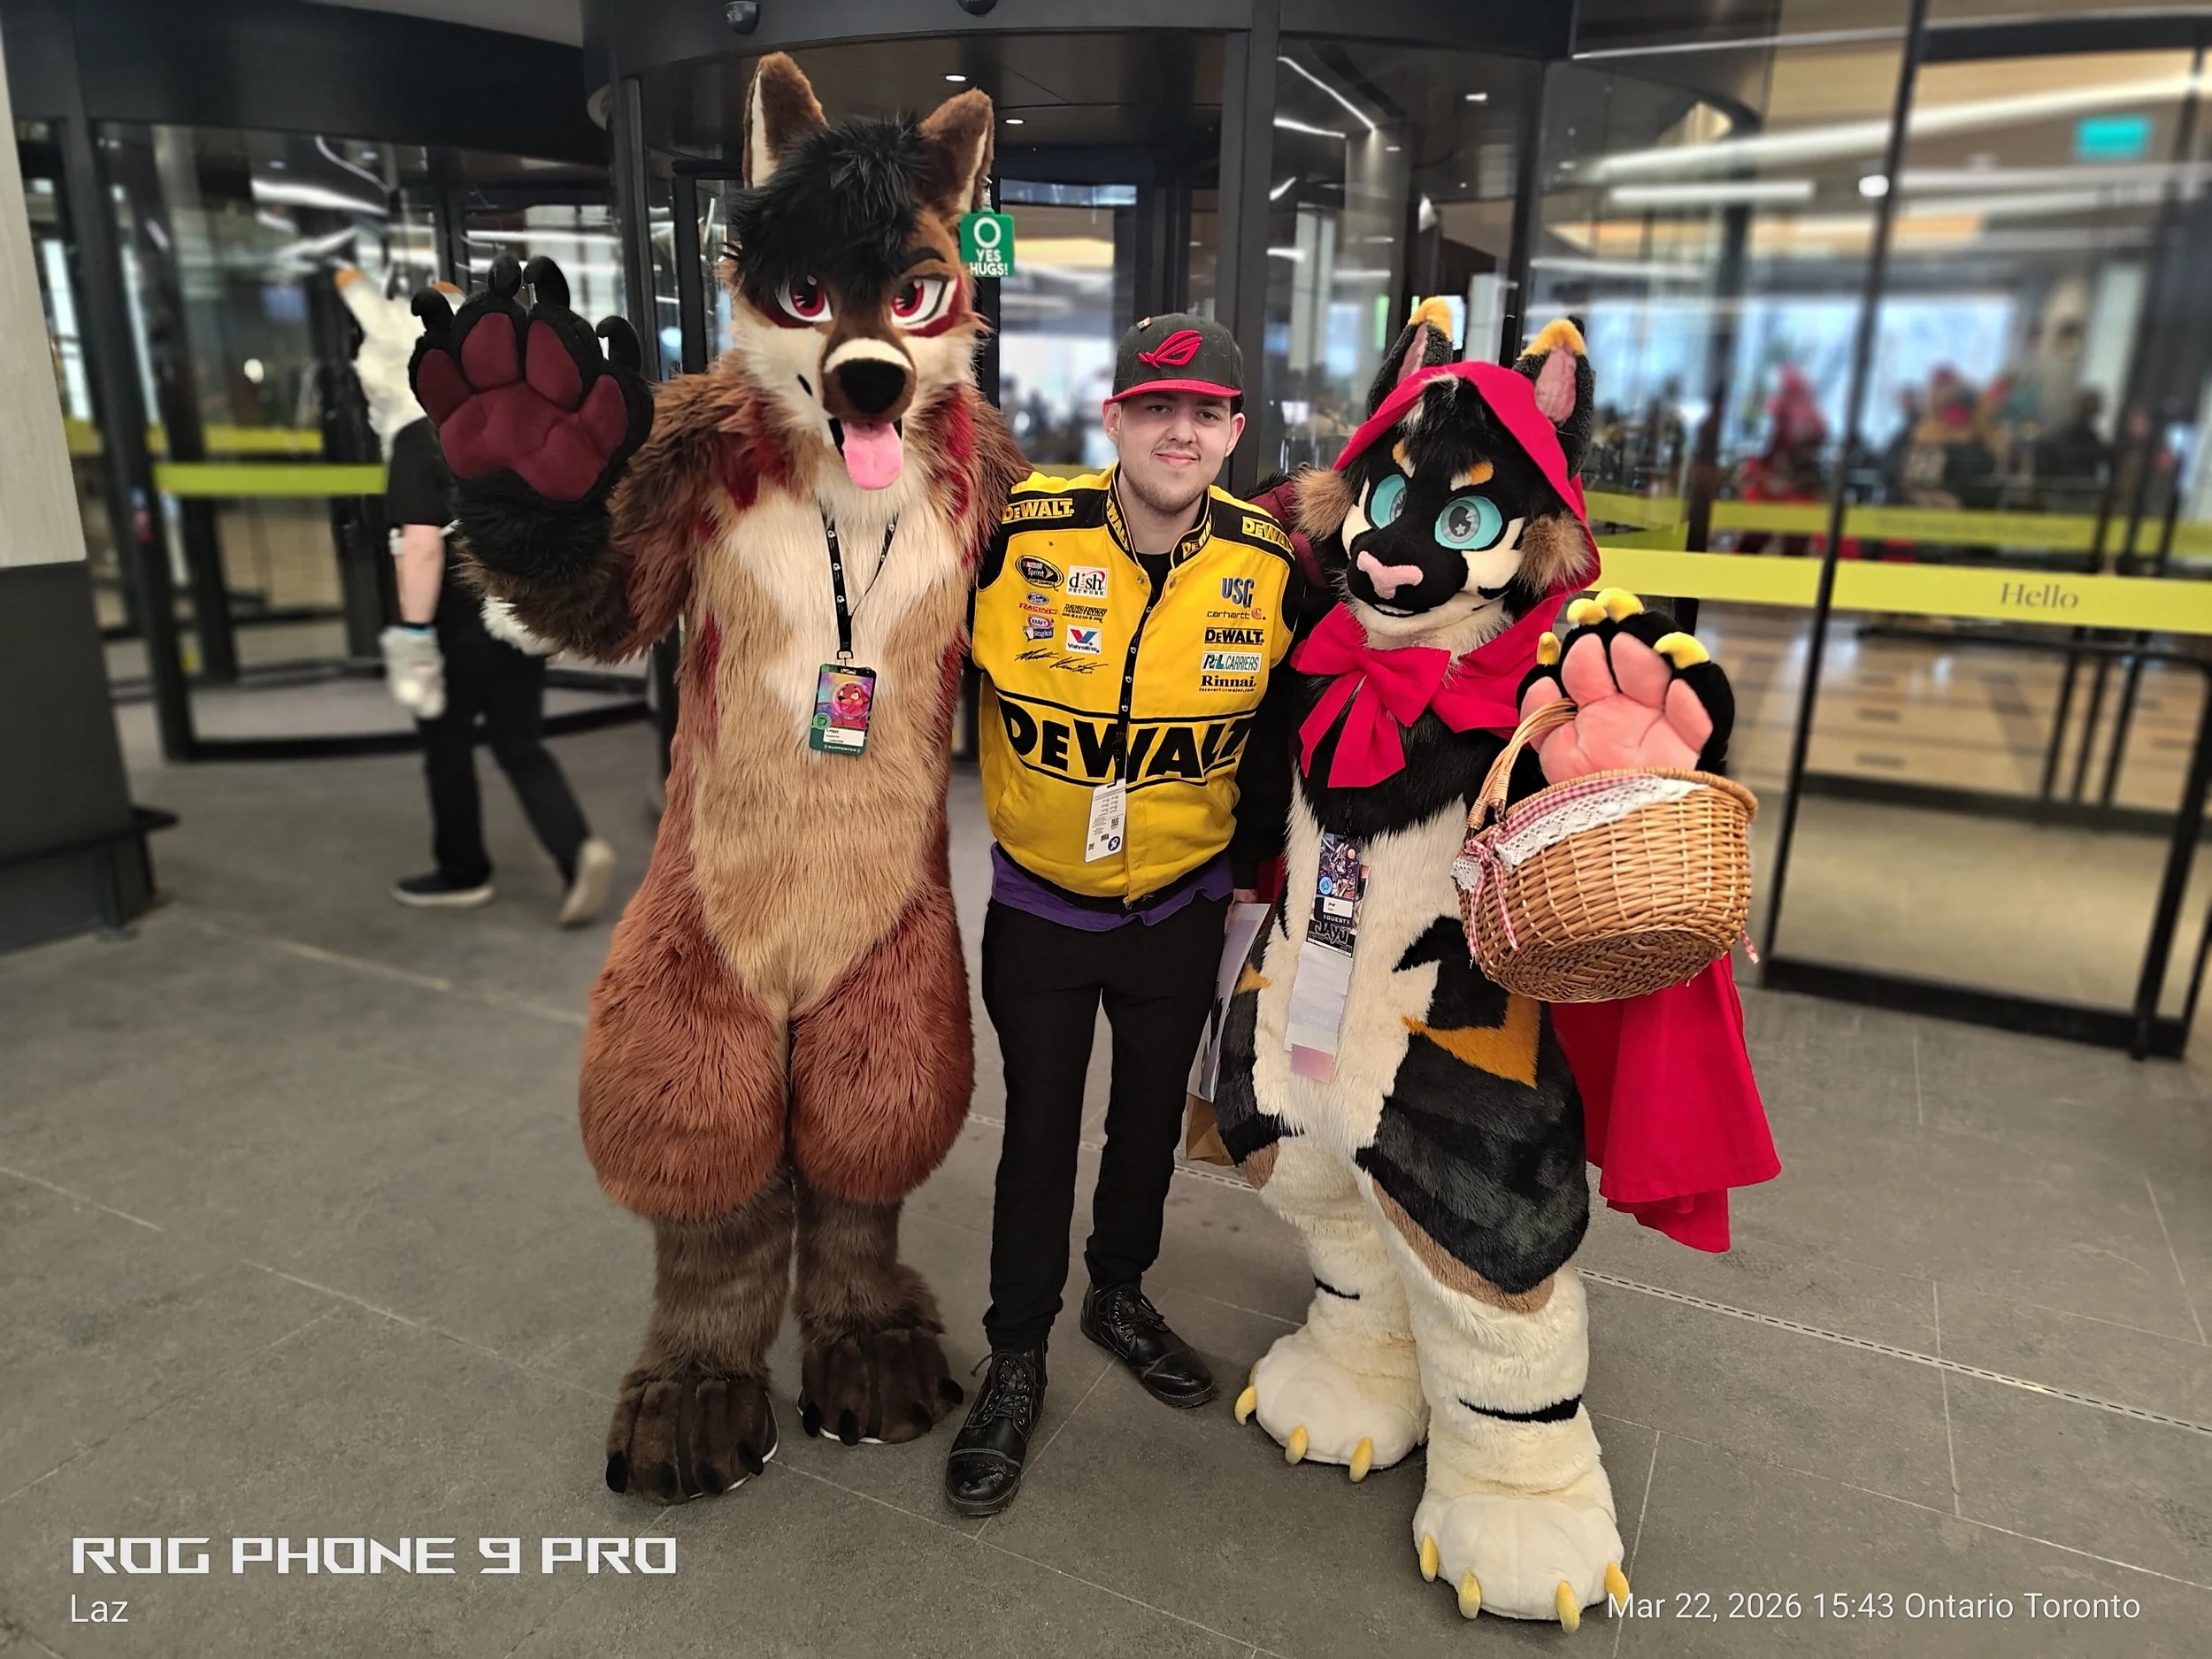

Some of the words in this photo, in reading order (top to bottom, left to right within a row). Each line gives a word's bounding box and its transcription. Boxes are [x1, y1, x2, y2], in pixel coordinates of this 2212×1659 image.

[976, 250, 1002, 262] YES
[970, 262, 1009, 276] HUGS!
[1002, 501, 1073, 521] DEWALT
[1027, 567, 1045, 578] Sprint
[1069, 571, 1103, 591] dish
[1068, 588, 1104, 596] NETWORK
[1222, 578, 1255, 609] USG
[2000, 582, 2079, 611] Hello
[1018, 603, 1058, 615] RACING
[1207, 611, 1251, 619] carhartt
[1204, 628, 1263, 644] DEWALT
[1067, 642, 1098, 653] Valvoline
[1225, 655, 1260, 672] CARRIERS
[1201, 675, 1255, 687] Rinnai
